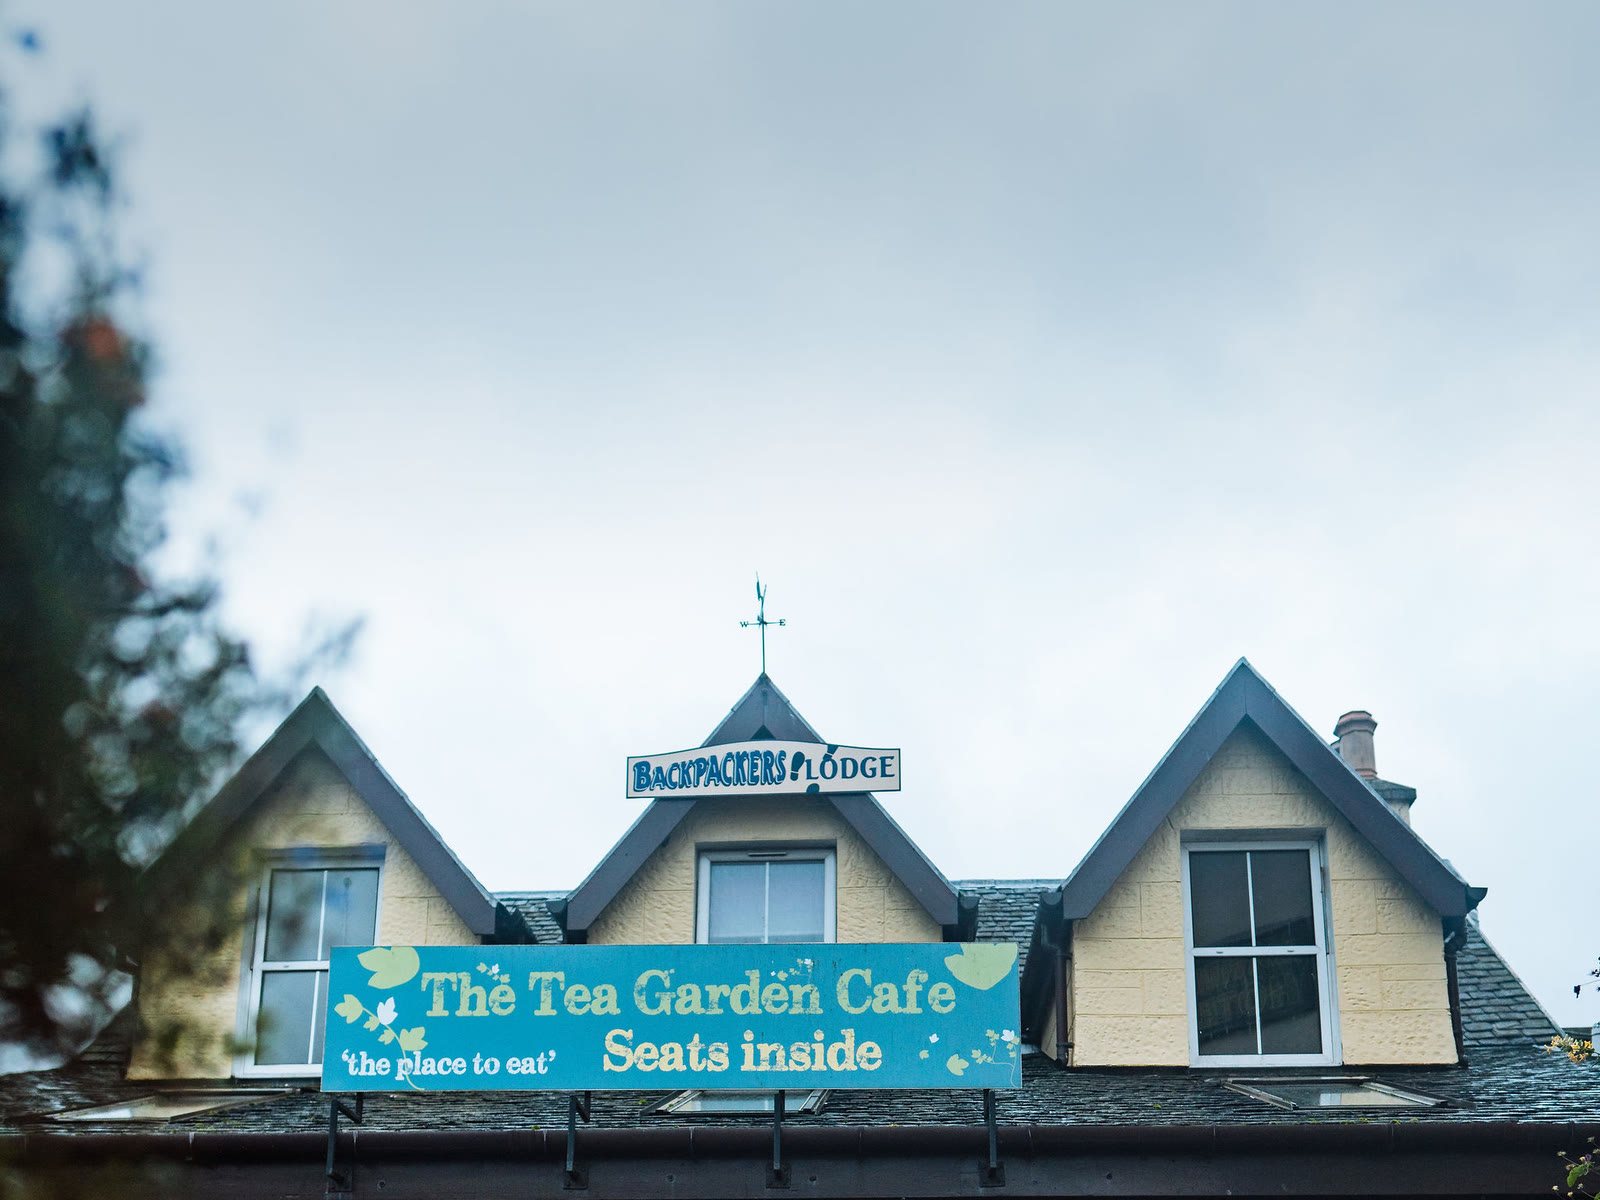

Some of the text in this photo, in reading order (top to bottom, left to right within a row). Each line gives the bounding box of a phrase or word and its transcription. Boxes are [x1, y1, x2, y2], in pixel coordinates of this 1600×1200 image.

[779, 618, 786, 627] E
[632, 750, 896, 792] BACKPACKERS LODGE
[421, 968, 957, 1017] The Tea Garden Cafe
[394, 1051, 467, 1081] place
[472, 1052, 501, 1075] to
[603, 1028, 883, 1072] Seats inside
